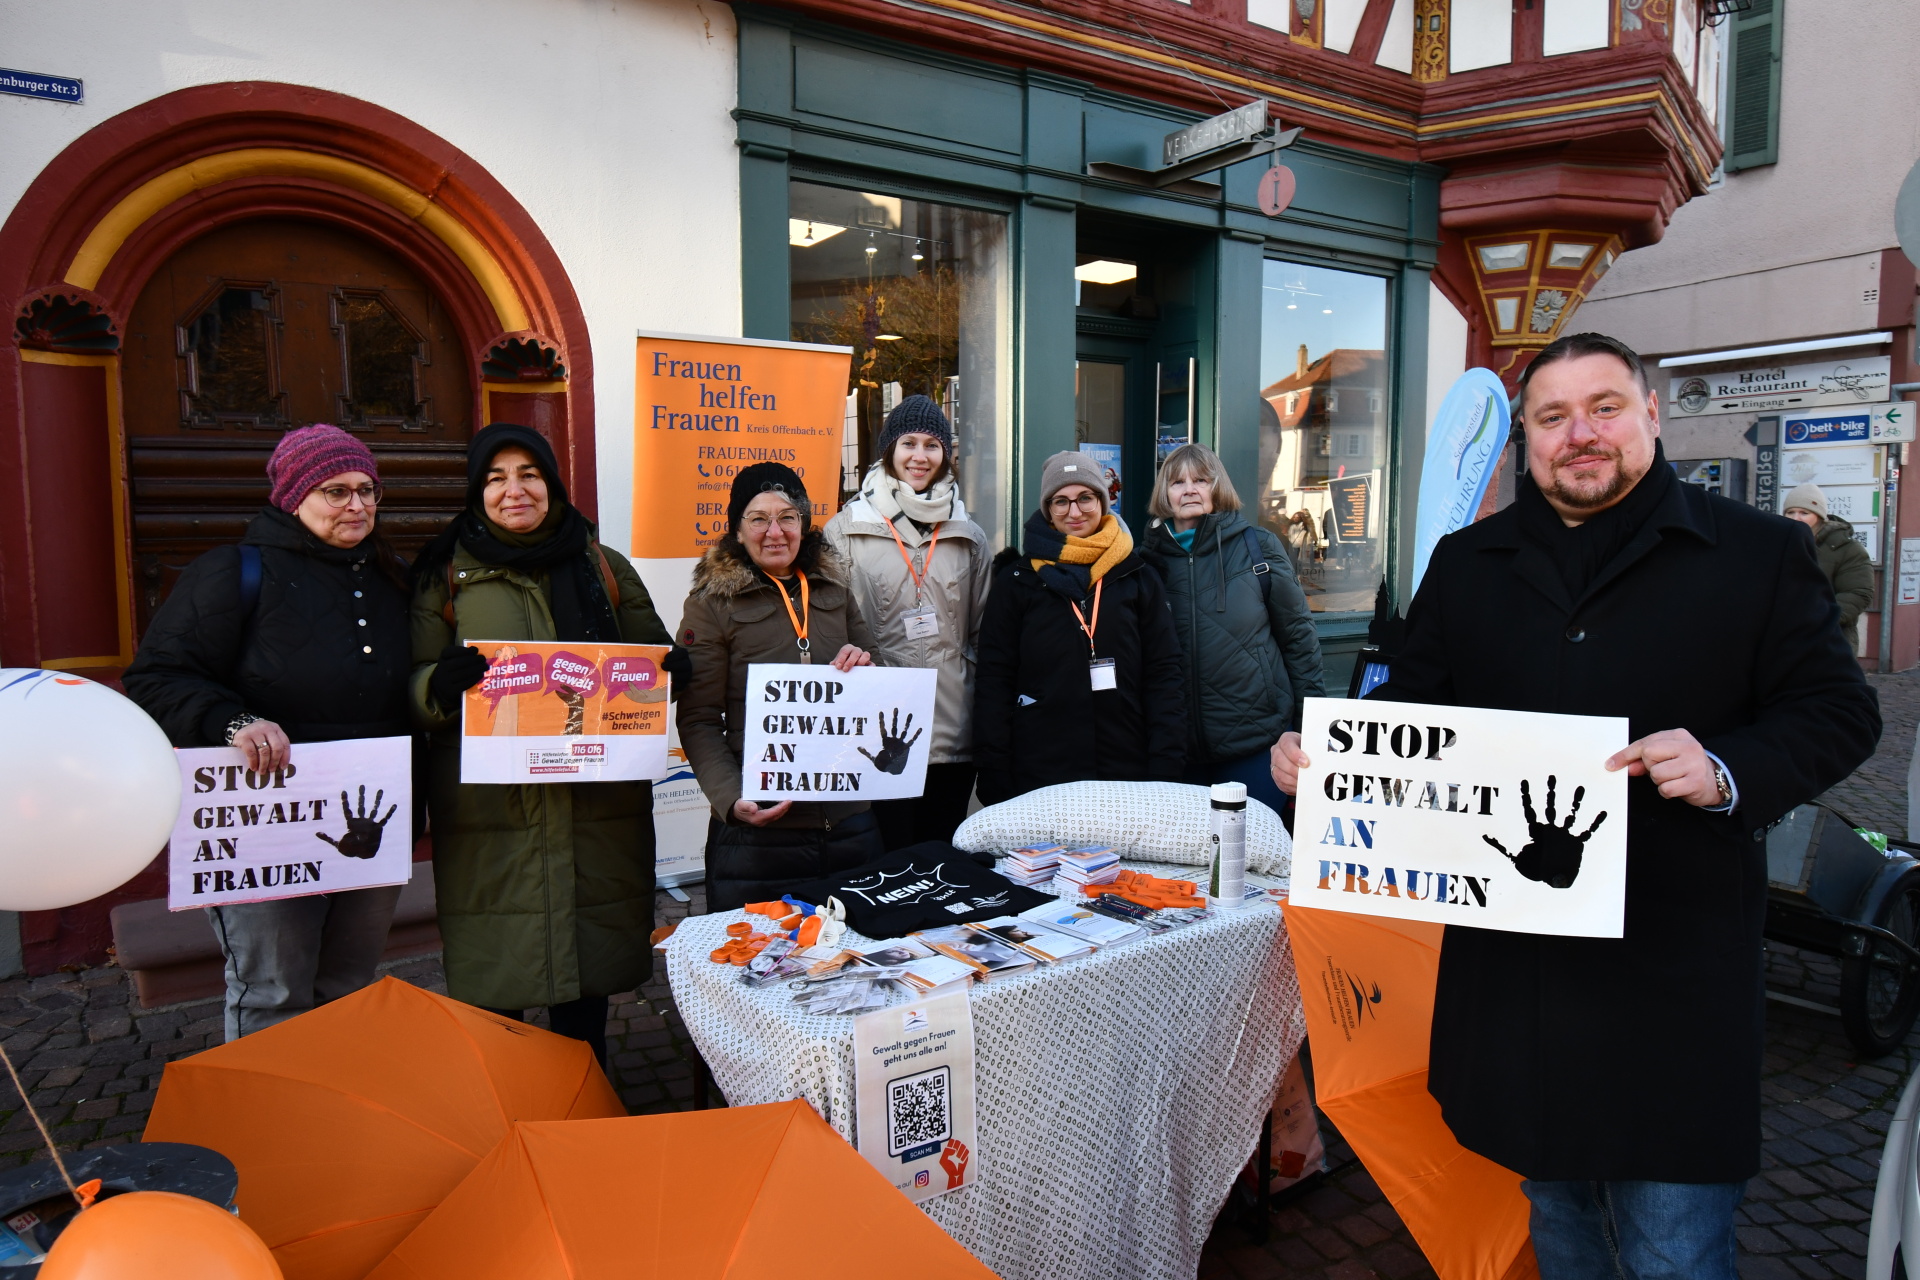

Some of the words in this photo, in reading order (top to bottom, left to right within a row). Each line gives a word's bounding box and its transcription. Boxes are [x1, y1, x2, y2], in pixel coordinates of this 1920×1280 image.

[652, 351, 742, 381] Frauen
[1739, 369, 1786, 384] Hotel
[699, 383, 776, 411] helfen
[1717, 379, 1808, 396] Restaurant
[1741, 399, 1785, 409] Eingang
[651, 405, 740, 432] Frauen
[746, 424, 770, 434] Kreis
[772, 425, 816, 435] Offenbach
[1454, 402, 1484, 461] Seligenstadt
[1847, 429, 1865, 437] adfc
[698, 446, 796, 461] FRAUENHAUS
[483, 662, 527, 678] Unsere
[552, 657, 590, 675] gegen
[612, 660, 627, 671] an
[482, 674, 540, 691] Stimmen
[551, 670, 595, 691] Gewalt
[611, 671, 650, 683] Frauen
[764, 680, 844, 703] STOP
[602, 710, 661, 723] #Schweigen
[611, 720, 652, 731] brechen
[762, 714, 867, 736] GEWALT
[573, 745, 586, 755] 116
[587, 745, 602, 754] 016
[1327, 718, 1457, 761] STOP
[541, 757, 563, 765] Gewalt
[761, 743, 797, 763] AN
[194, 763, 297, 794] STOP
[760, 771, 862, 792] FRAUEN
[669, 788, 695, 798] HELFEN
[1324, 772, 1499, 816] GEWALT
[193, 799, 328, 830] GEWALT
[1318, 816, 1377, 850] AN
[193, 837, 239, 862] AN
[192, 860, 323, 894] FRAUEN
[1316, 859, 1492, 908] FRAUEN
[876, 879, 935, 904] NEIN!
[872, 1041, 902, 1056] Gewalt
[903, 1035, 928, 1050] gegen
[929, 1028, 956, 1042] Frauen
[883, 1053, 902, 1068] geht
[903, 1052, 917, 1061] uns
[918, 1046, 933, 1056] alle
[934, 1041, 947, 1052] an!
[909, 1148, 924, 1159] SCAN
[925, 1146, 933, 1154] ME
[901, 1179, 912, 1189] auf
